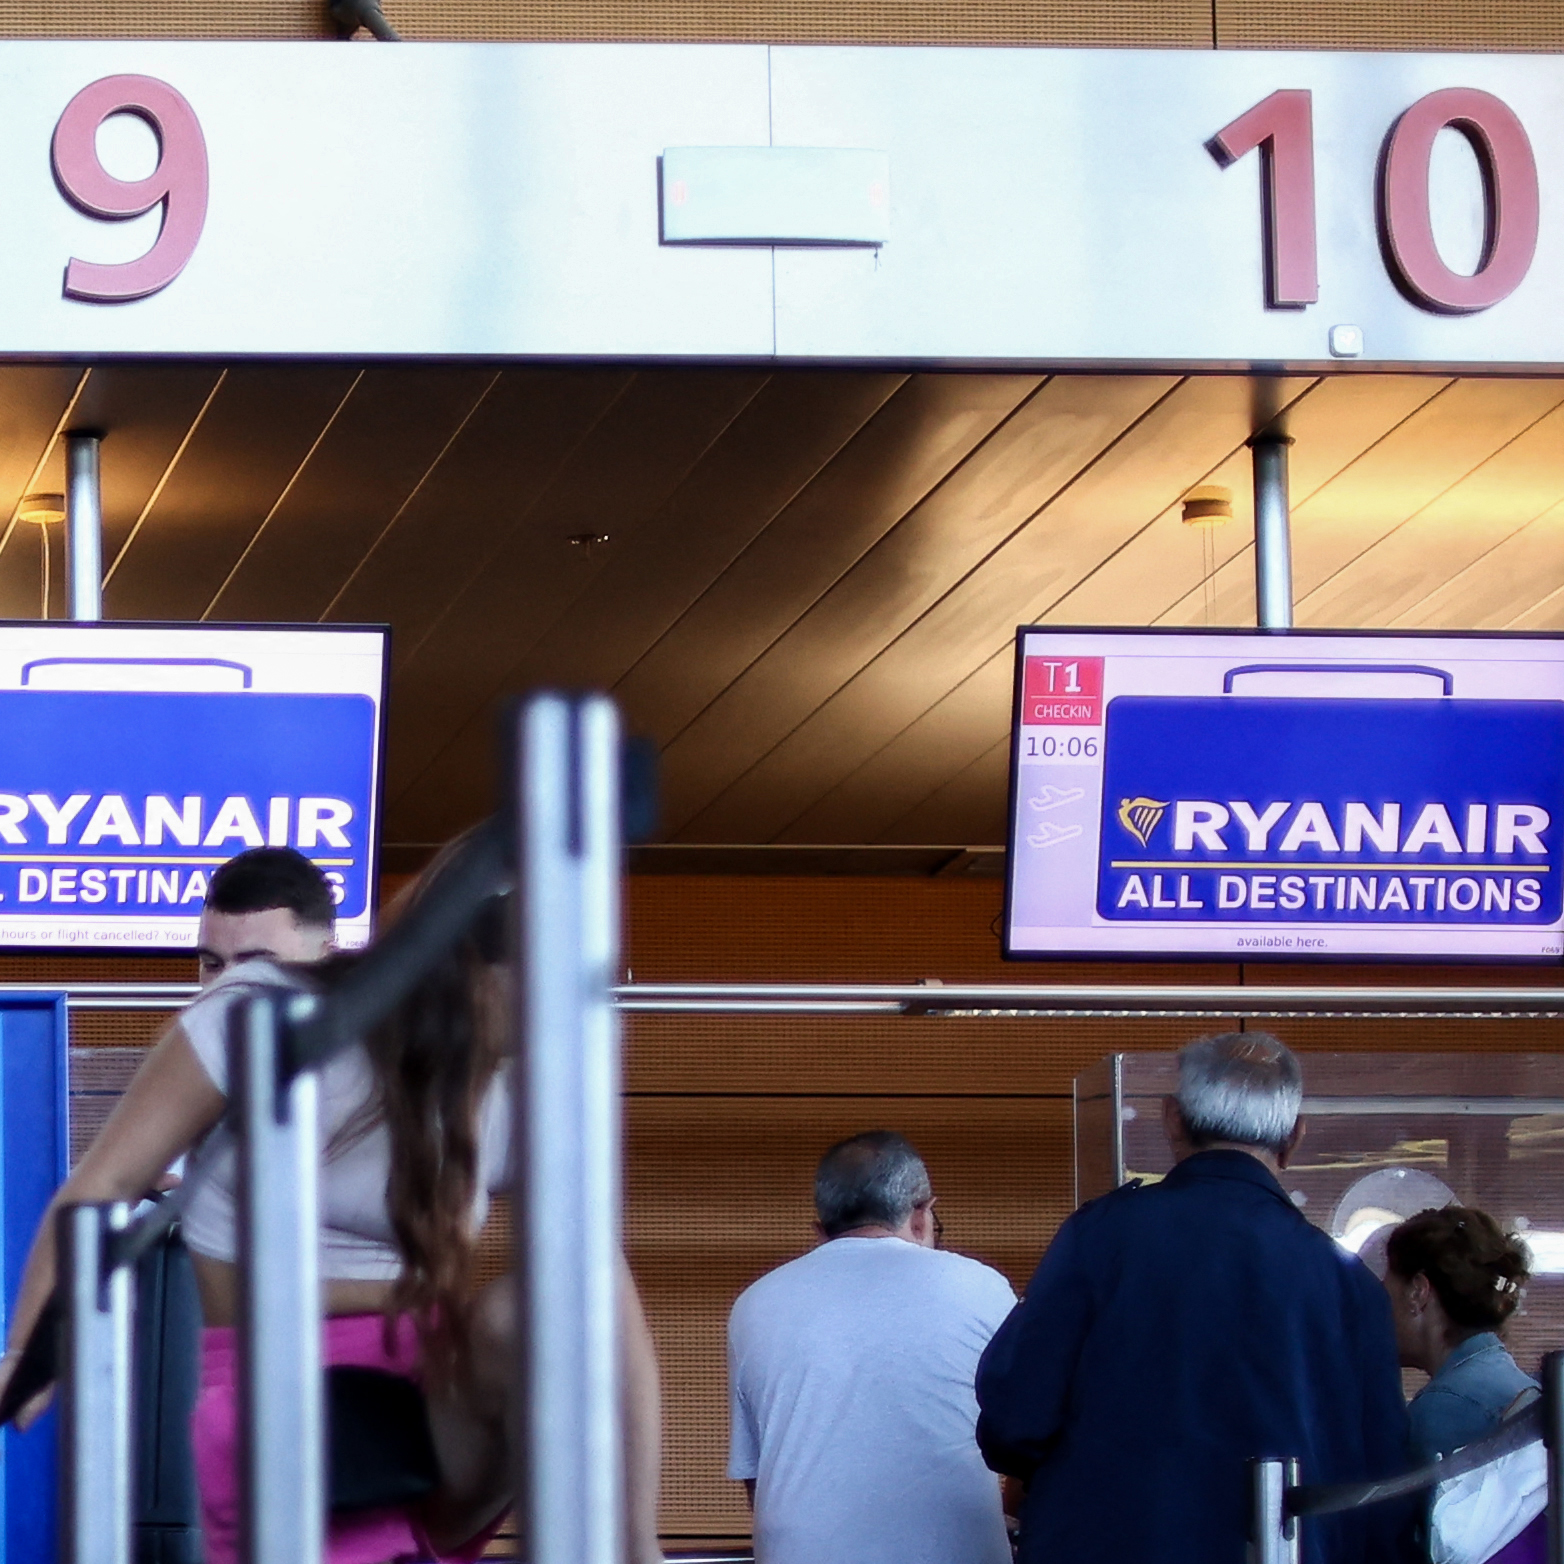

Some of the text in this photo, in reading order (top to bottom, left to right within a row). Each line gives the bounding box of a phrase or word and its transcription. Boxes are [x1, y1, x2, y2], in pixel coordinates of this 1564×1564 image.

[50, 74, 209, 304] 9
[1204, 87, 1540, 314] 10
[1043, 662, 1082, 694] T1
[1034, 703, 1092, 719] CHECKIN
[1026, 735, 1098, 758] 10:06
[1173, 801, 1551, 855] RYANAIR
[18, 868, 346, 906] DESTINAS
[1118, 874, 1541, 912] ALL DESTINATIONS
[2, 928, 36, 940] hours
[40, 931, 53, 940] or
[57, 928, 90, 943] flight
[94, 928, 160, 942] cancelled?
[164, 930, 193, 942] Your
[1236, 936, 1328, 948] available here.
